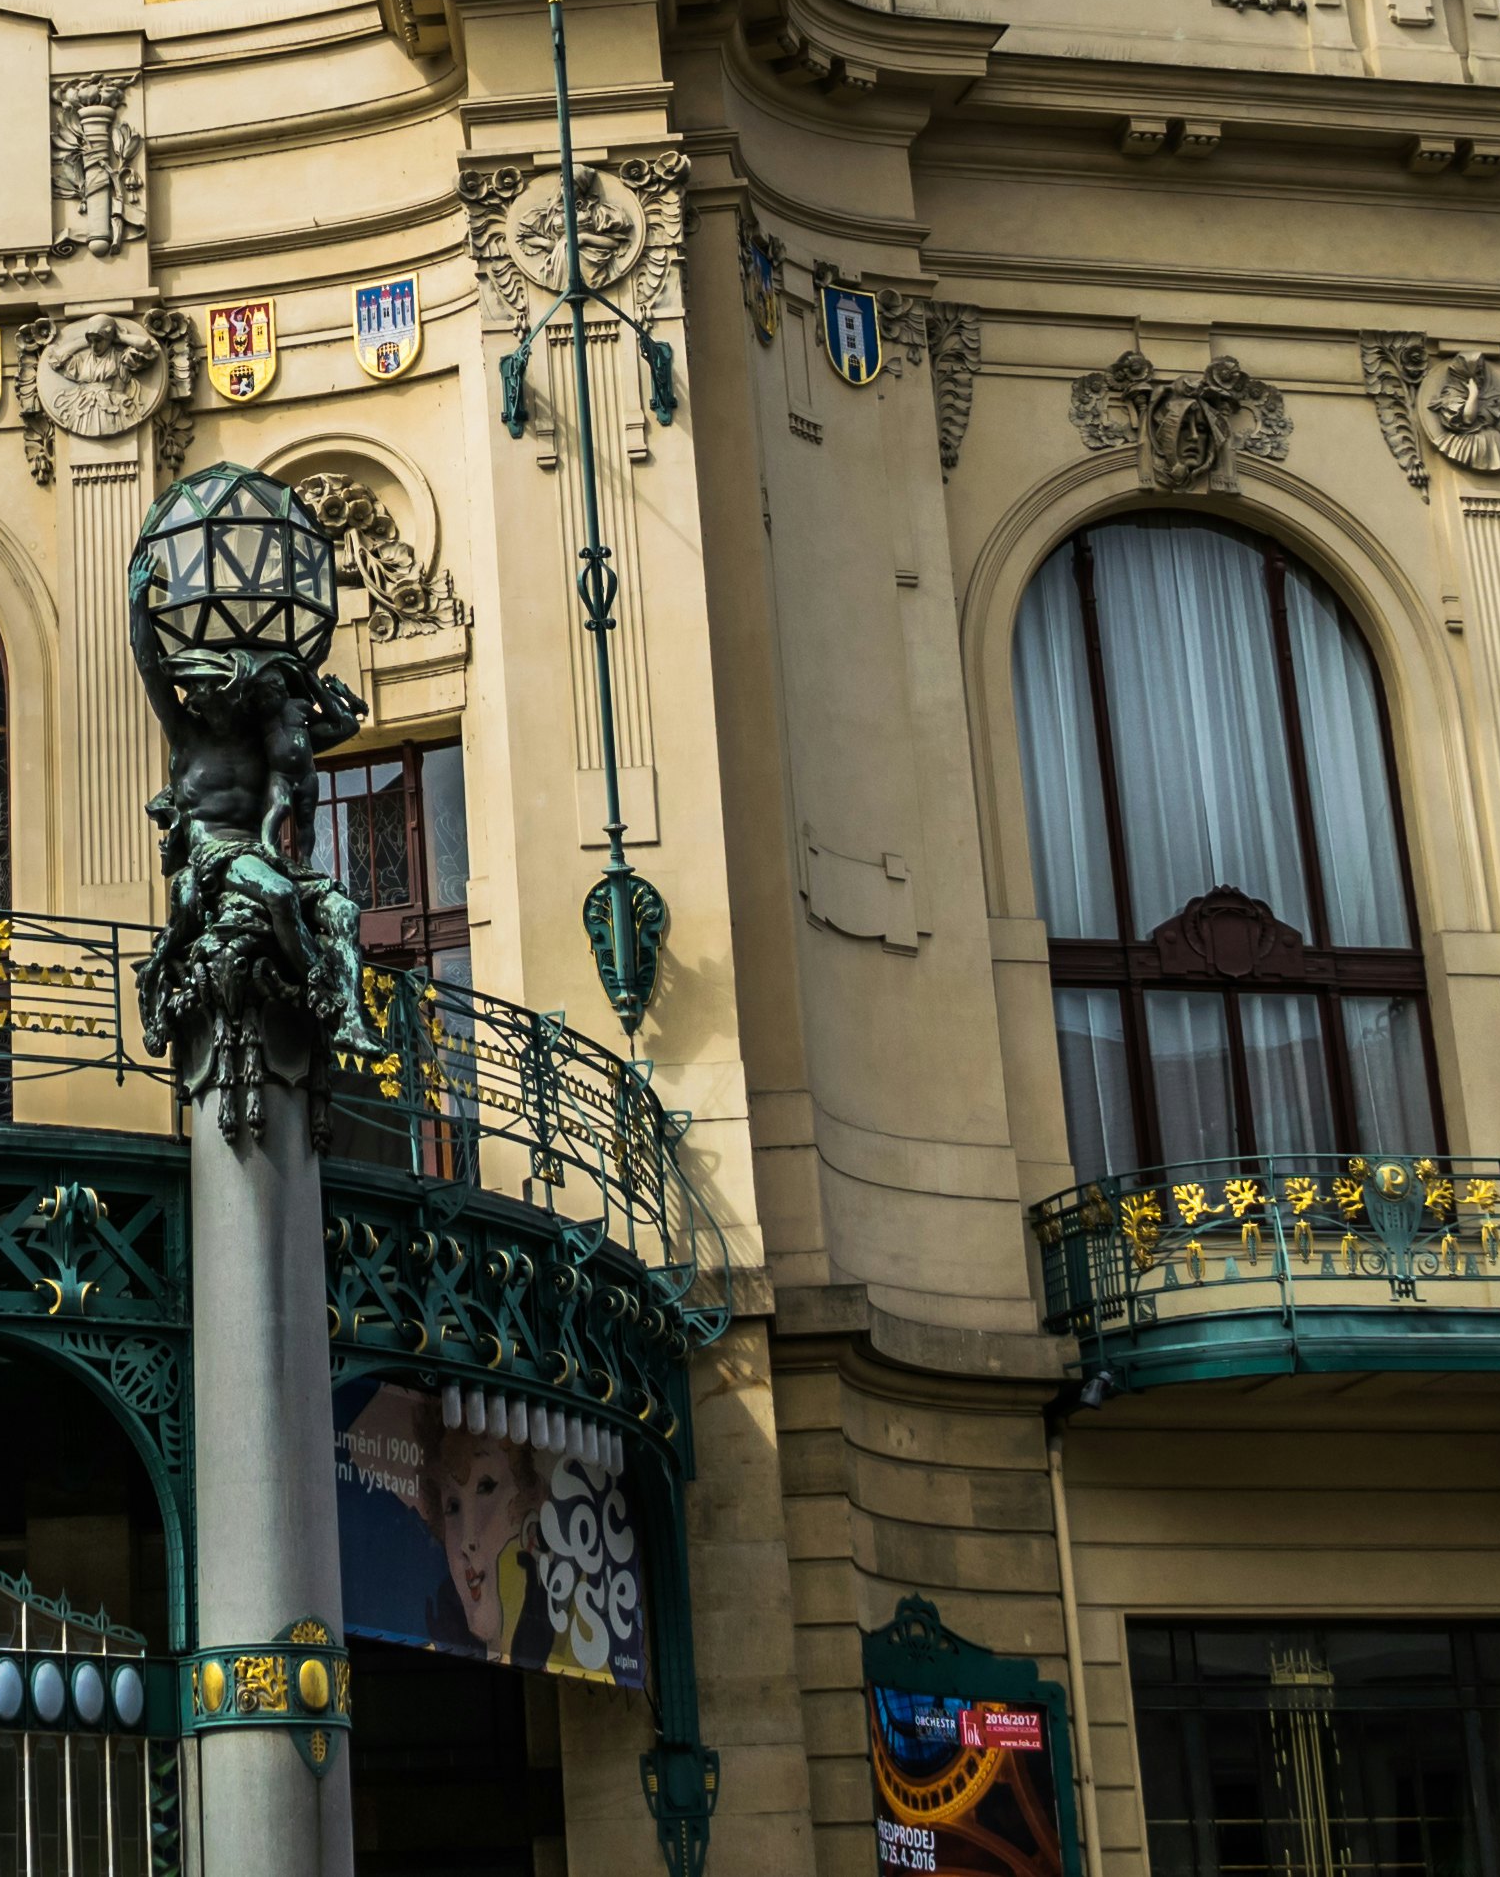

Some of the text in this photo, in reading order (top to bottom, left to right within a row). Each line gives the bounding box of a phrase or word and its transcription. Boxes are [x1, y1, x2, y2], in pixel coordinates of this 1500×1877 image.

[358, 1463, 419, 1498] výstava!
[914, 1715, 956, 1729] ORCHESTR
[962, 1710, 982, 1746] fok
[985, 1713, 1038, 1726] 2016/2017
[876, 1815, 935, 1850] PŘEDPRODEJ
[910, 1849, 936, 1872] 2016
